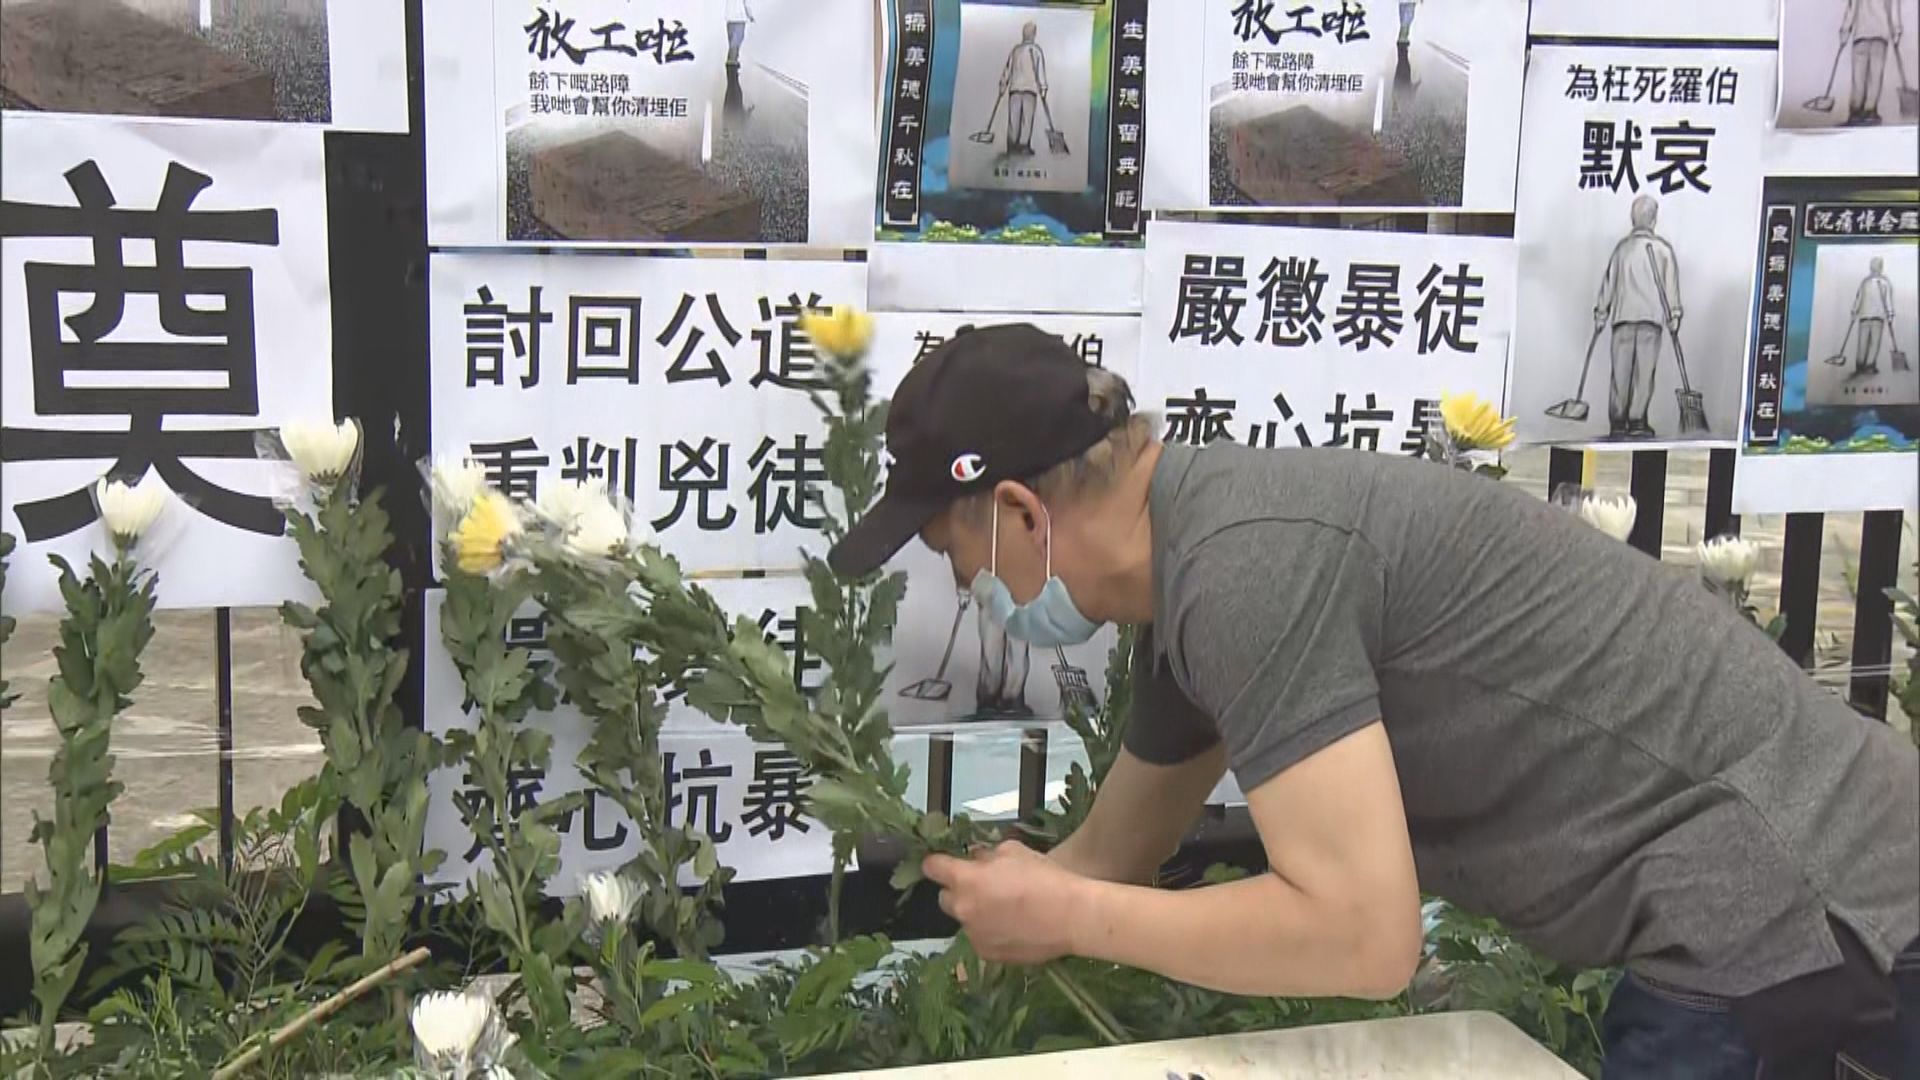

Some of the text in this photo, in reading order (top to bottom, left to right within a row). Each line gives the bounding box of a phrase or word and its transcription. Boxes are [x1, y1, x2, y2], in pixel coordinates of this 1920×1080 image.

[523, 7, 695, 65] 放工啦
[1232, 51, 1315, 71] 餘下嘅路障
[528, 71, 631, 94] 餘下嘅路障
[529, 94, 688, 118] 我哋會幫你清埋佢
[1564, 63, 1739, 106] 為枉死羅伯
[1578, 119, 1716, 196] 默哀
[1168, 253, 1486, 355] 嚴懲暴徒
[0, 158, 290, 544] 奠
[463, 284, 835, 389] 討回公道
